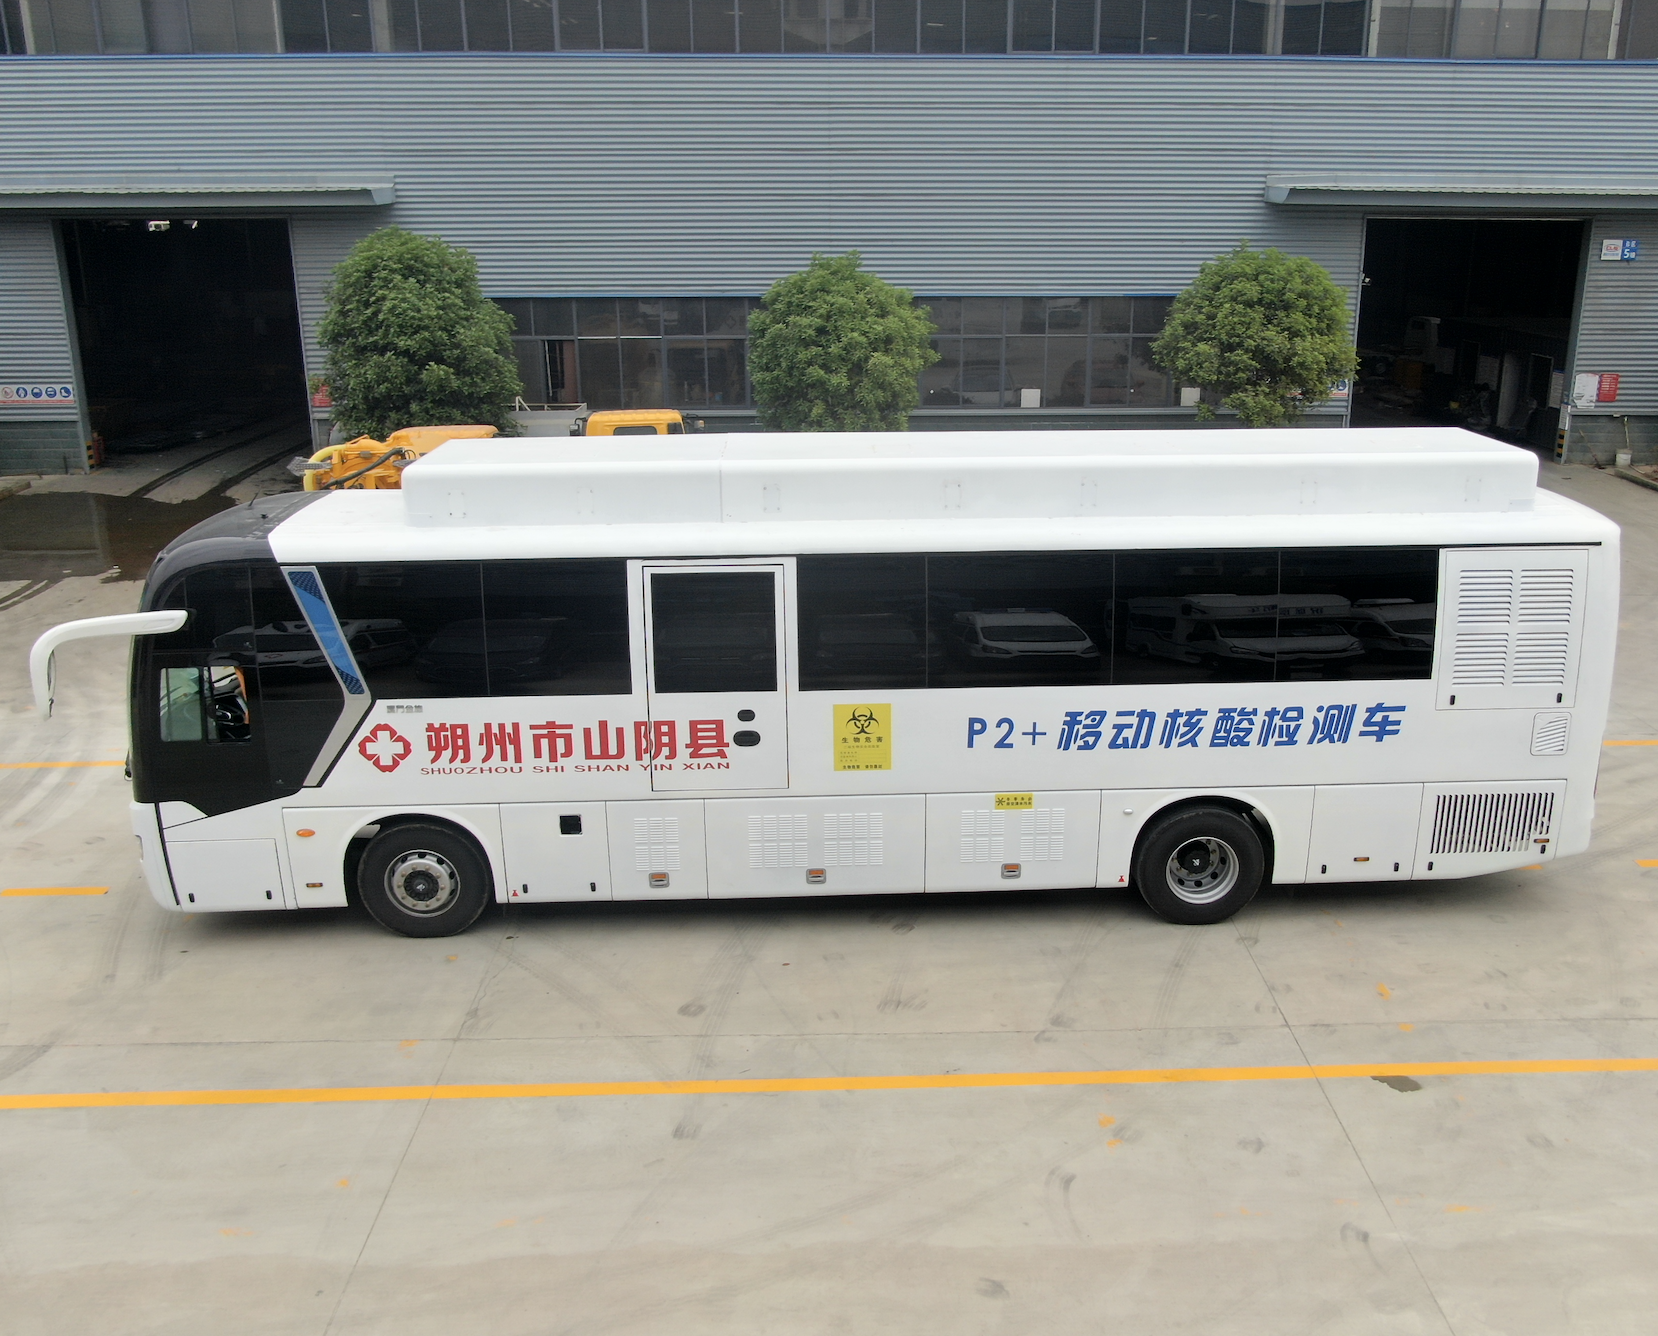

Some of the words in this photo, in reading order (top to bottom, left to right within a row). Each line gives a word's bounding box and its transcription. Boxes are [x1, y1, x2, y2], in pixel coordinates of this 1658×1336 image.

[425, 719, 731, 765] 朔州市山阴县
[420, 766, 524, 775] SHUOZHOU
[532, 765, 566, 773] SHI
[574, 764, 630, 773] SHAN
[639, 763, 673, 772] YIN
[682, 762, 731, 771] XIAN
